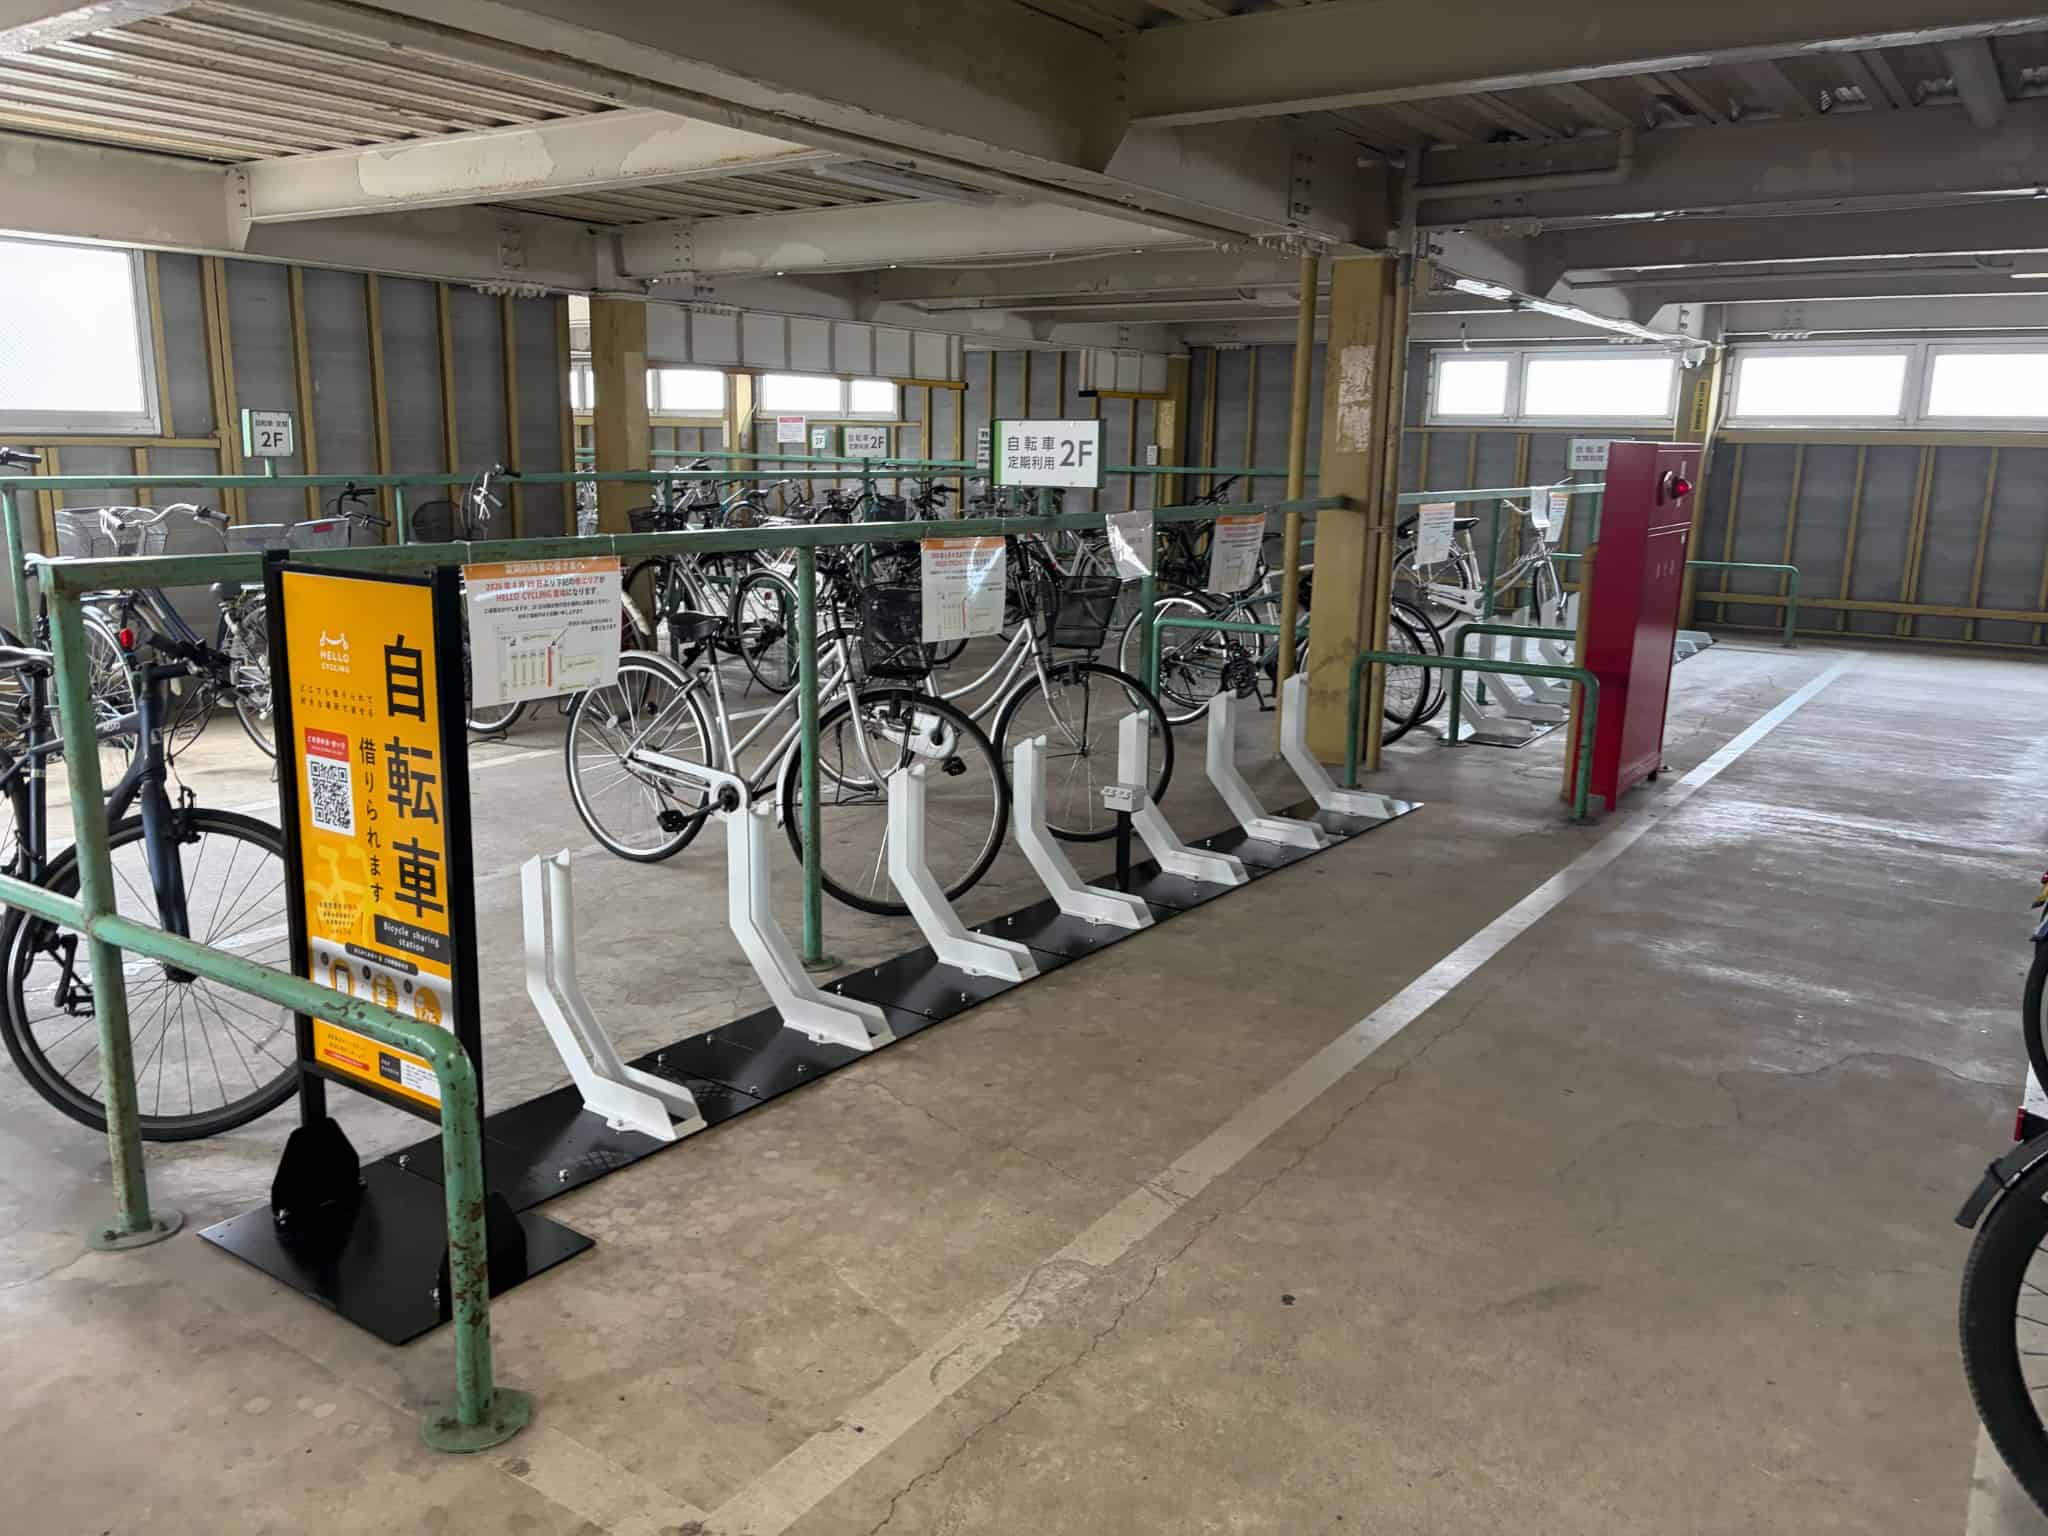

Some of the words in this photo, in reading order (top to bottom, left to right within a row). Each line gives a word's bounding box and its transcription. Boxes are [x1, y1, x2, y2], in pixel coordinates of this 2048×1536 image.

[261, 431, 283, 448] 2F
[870, 436, 884, 449] 2F
[1007, 436, 1056, 451] 自転車
[1060, 440, 1093, 467] 2F
[1007, 456, 1056, 471] 定期利用
[320, 650, 349, 664] HELLO
[383, 633, 444, 918] 自転車
[359, 736, 384, 903] 借りられます
[383, 920, 409, 937] Bicycle
[412, 929, 440, 949] sharing
[399, 938, 425, 952] station
